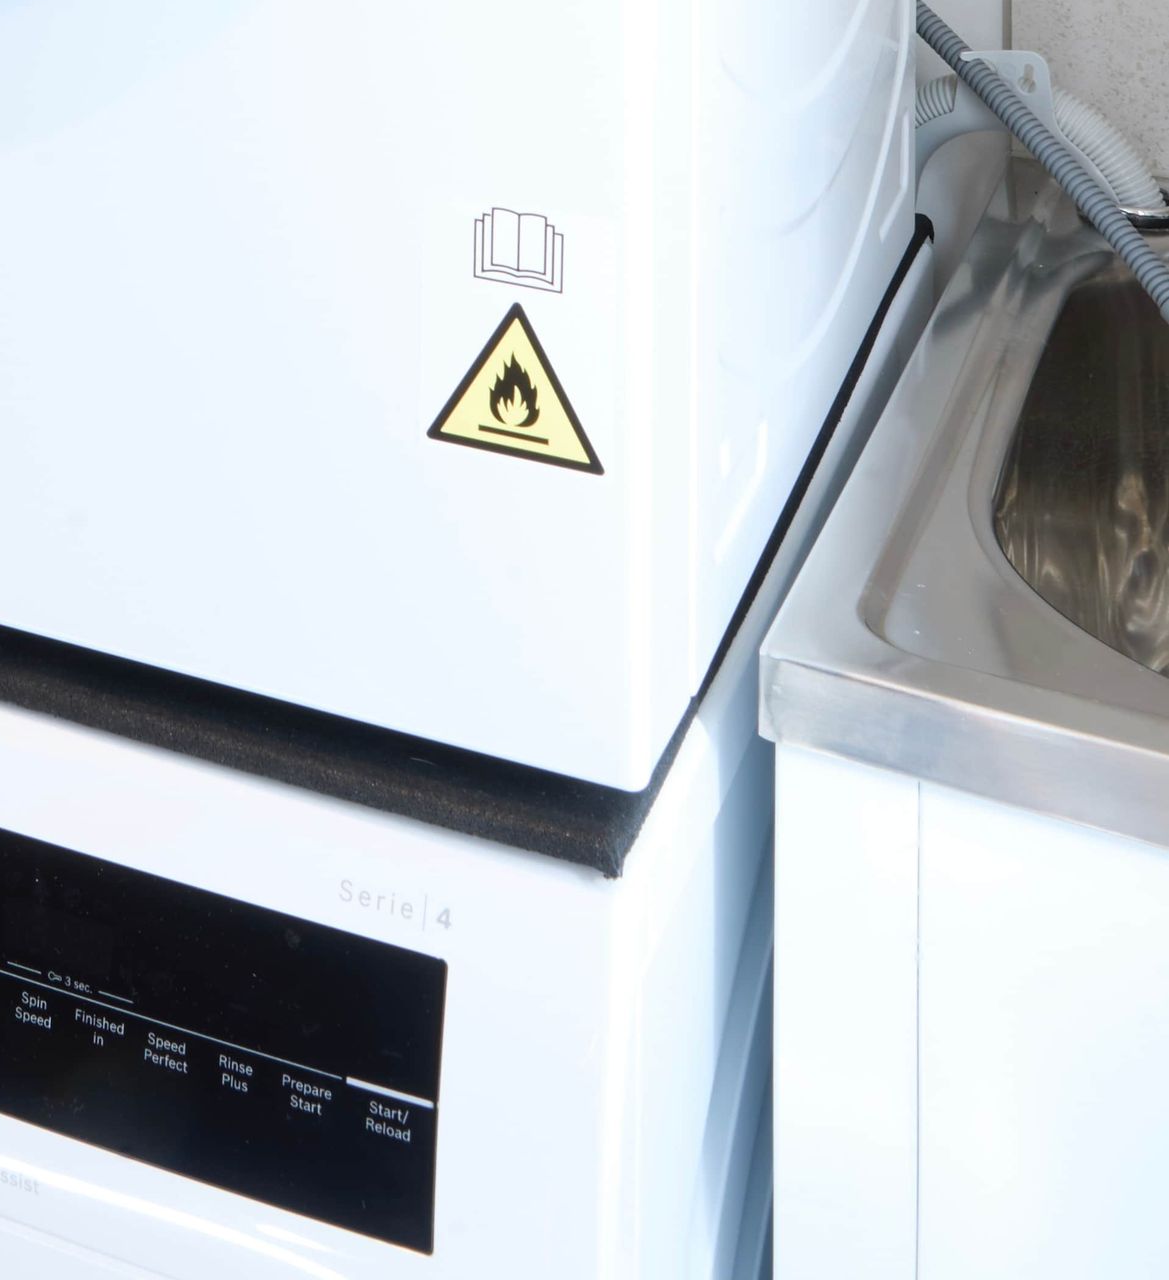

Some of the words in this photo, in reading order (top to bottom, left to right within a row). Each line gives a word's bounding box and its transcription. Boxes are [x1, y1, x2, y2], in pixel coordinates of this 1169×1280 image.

[339, 879, 415, 920] Serie
[435, 908, 452, 929] 4
[64, 976, 73, 989] 3
[74, 980, 93, 994] sec.
[21, 991, 47, 1012] Spin
[15, 1007, 52, 1030] Speed
[75, 1008, 125, 1037] Finished
[93, 1033, 104, 1047] in
[147, 1032, 186, 1057] Speed
[143, 1049, 188, 1075] Perfect
[219, 1054, 253, 1076] Rinse
[221, 1073, 249, 1093] Plus
[282, 1074, 332, 1101] Prepare
[290, 1095, 322, 1117] Start
[369, 1101, 410, 1125] Start/
[365, 1117, 412, 1142] Reload
